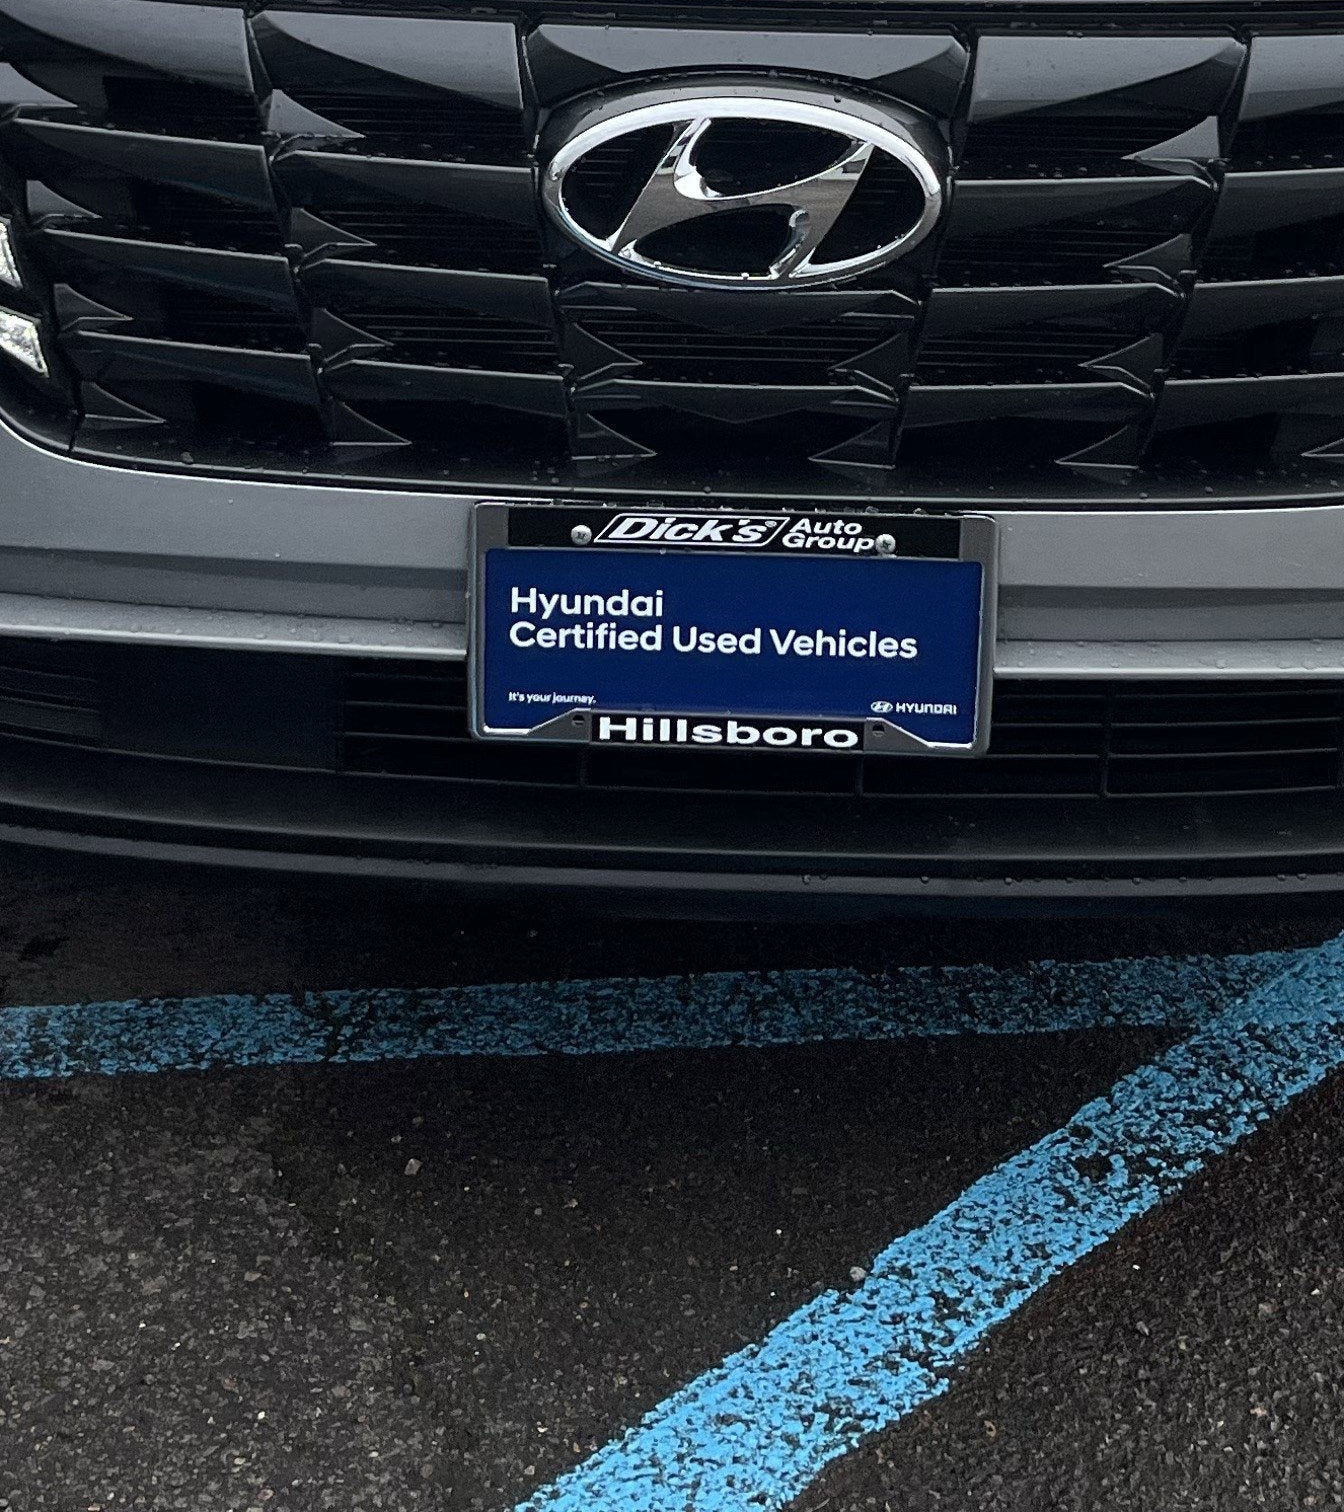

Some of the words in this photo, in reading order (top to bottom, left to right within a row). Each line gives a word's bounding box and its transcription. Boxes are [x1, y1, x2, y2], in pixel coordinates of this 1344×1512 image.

[789, 517, 863, 535] Auto
[782, 532, 874, 553] Group
[511, 586, 664, 619] Hyundai
[509, 620, 663, 651] Certified
[672, 625, 762, 655] Used
[769, 628, 918, 659] Vehicles
[508, 691, 525, 702] It's
[526, 693, 551, 704] your
[895, 701, 958, 716] HYUNDAI
[599, 716, 859, 749] Hillsboro
